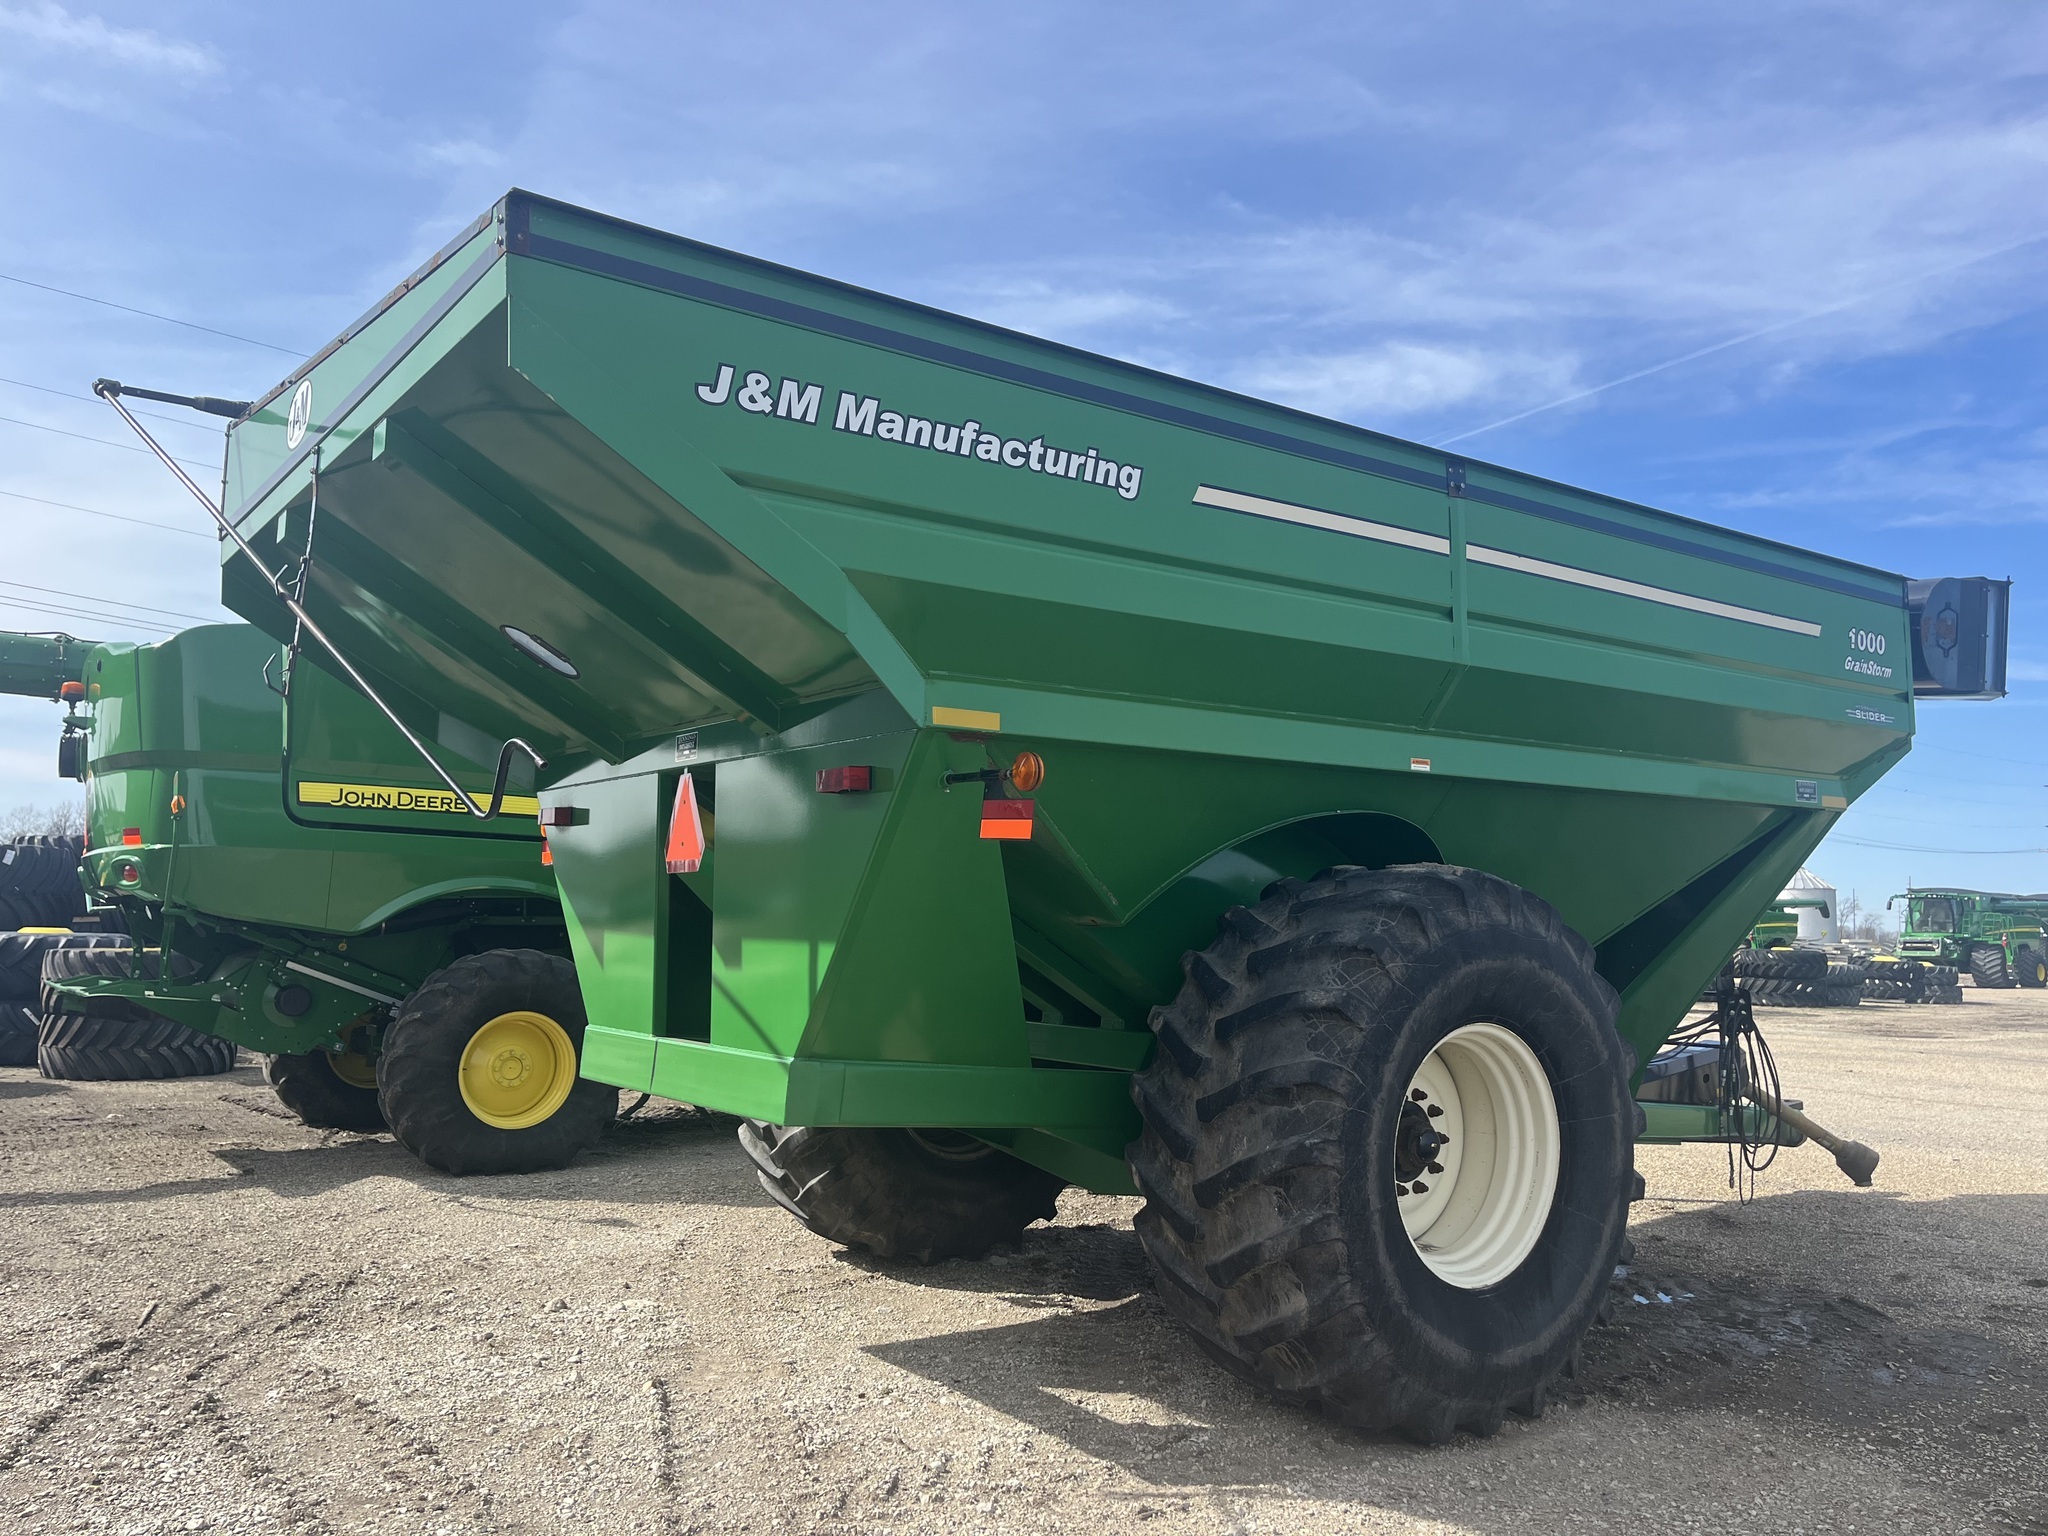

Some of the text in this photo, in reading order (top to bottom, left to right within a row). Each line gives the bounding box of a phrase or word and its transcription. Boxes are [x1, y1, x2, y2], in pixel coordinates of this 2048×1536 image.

[695, 362, 1143, 500] J&M Manufacturing
[1848, 627, 1886, 655] 1000
[1844, 656, 1892, 678] GrainStorm
[1855, 709, 1886, 722] SLIDER
[331, 788, 465, 810] JOHN DEERE
